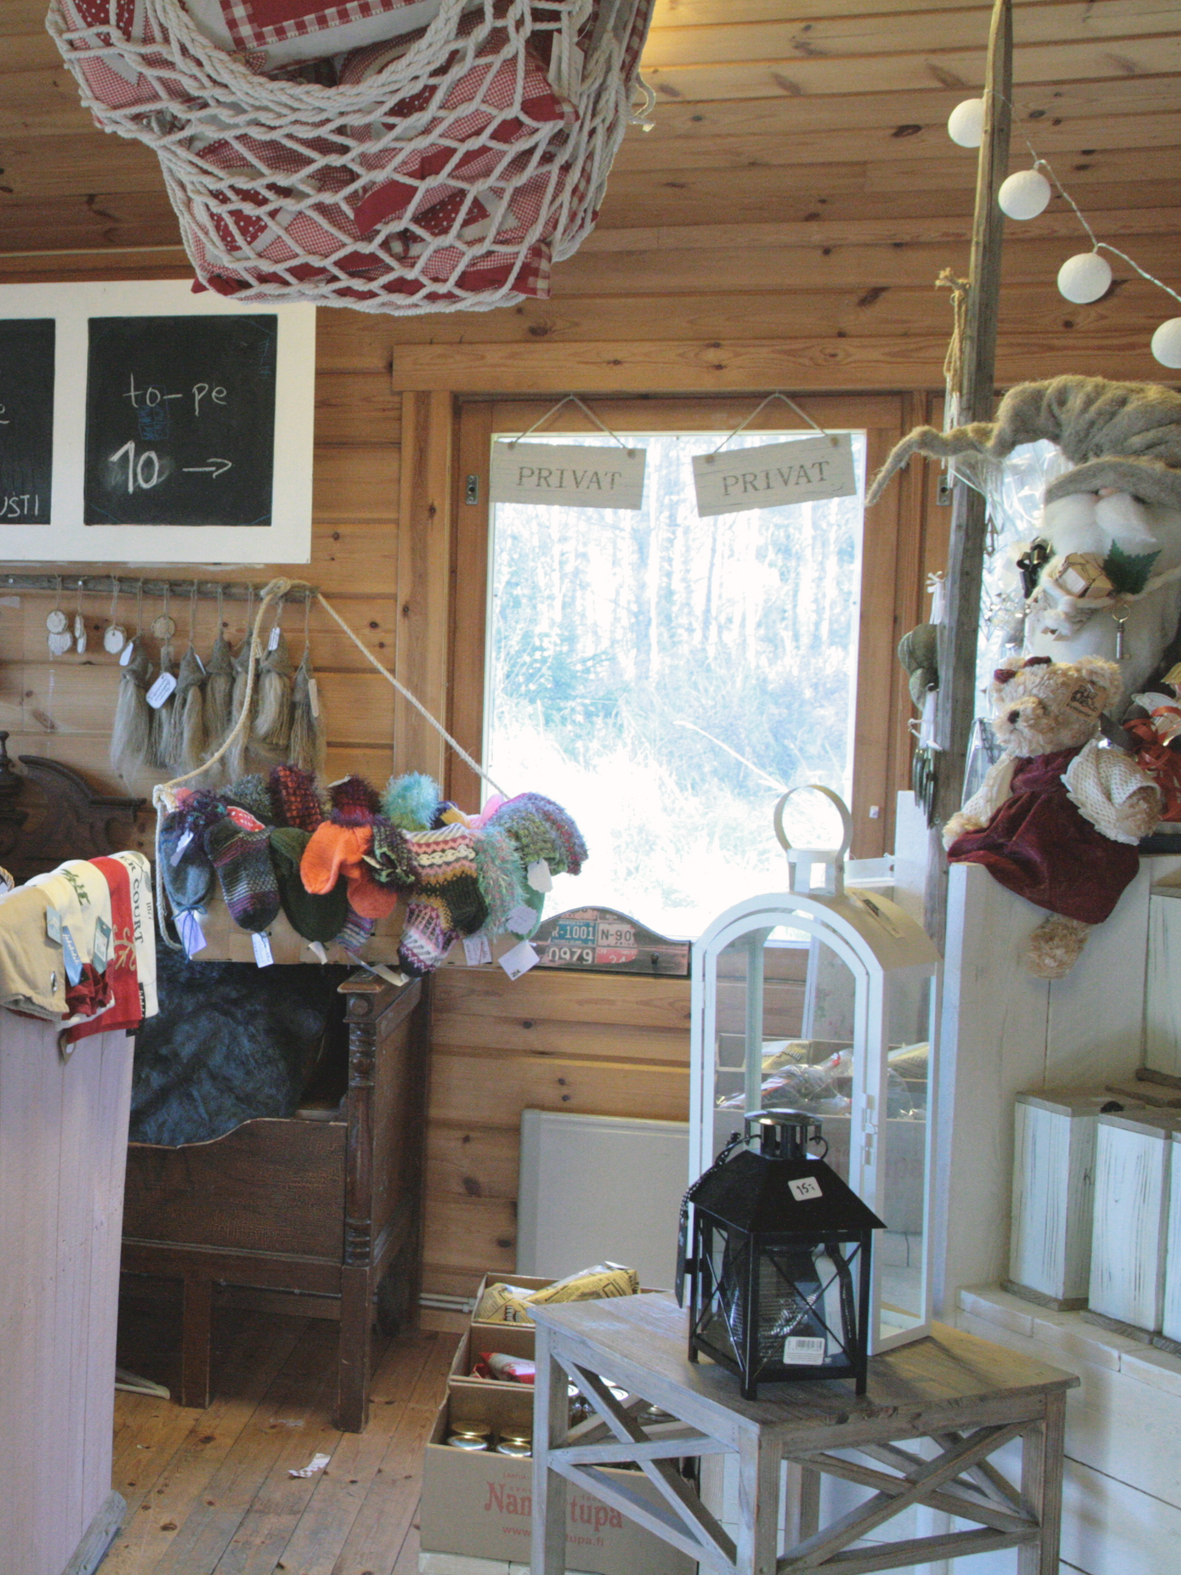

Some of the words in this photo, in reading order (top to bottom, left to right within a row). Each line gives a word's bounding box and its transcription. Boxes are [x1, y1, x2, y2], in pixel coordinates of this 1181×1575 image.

[107, 439, 161, 495] 10
[516, 465, 623, 492] PRIVAT
[721, 459, 832, 497] PRIVAT
[131, 878, 145, 944] COURT
[548, 946, 594, 965] 0979
